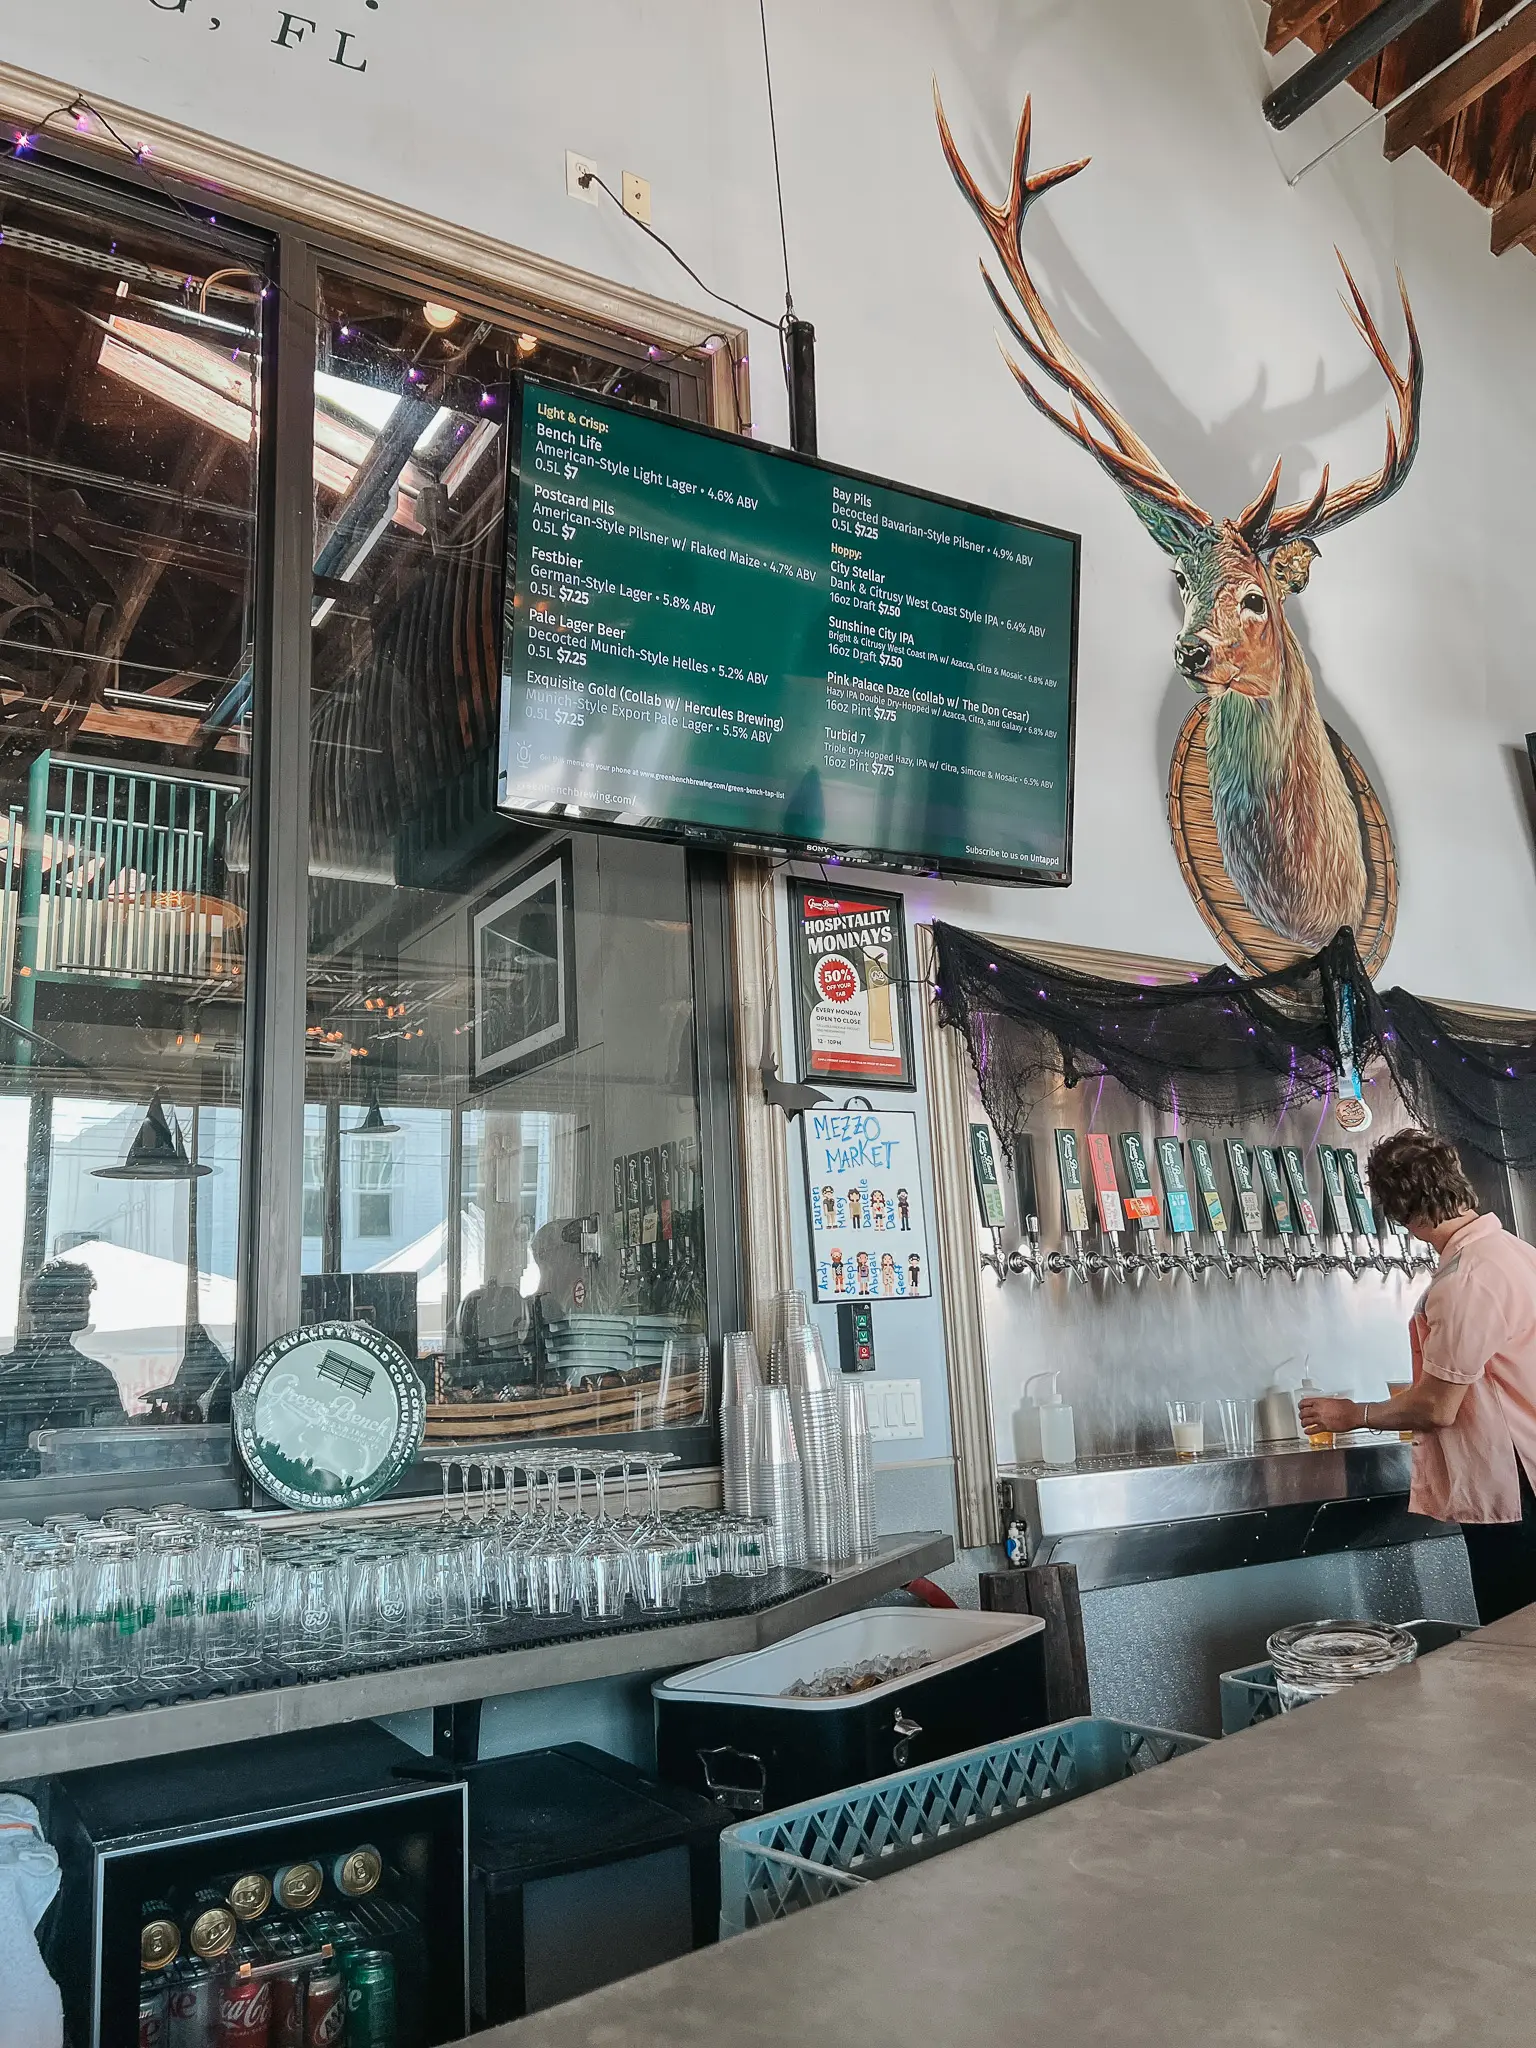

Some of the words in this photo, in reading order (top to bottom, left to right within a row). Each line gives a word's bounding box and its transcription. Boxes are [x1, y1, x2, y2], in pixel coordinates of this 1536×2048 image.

[271, 10, 367, 72] FL
[537, 402, 566, 421] Light
[567, 411, 577, 424] &
[579, 415, 609, 434] Crisp:
[537, 422, 576, 445] Bench
[579, 434, 602, 452] Life
[535, 457, 561, 475] 0.5L
[563, 463, 579, 480] $7
[535, 440, 630, 476] American-Style
[633, 466, 663, 486] Light
[666, 475, 698, 494] Lager
[707, 487, 734, 505] 4.6%
[736, 495, 759, 511] ABV
[534, 483, 589, 510] Postcard
[592, 499, 615, 516] Pils
[833, 486, 852, 504] Bay
[854, 492, 872, 508] Pils
[532, 518, 559, 536] 0.5L
[561, 524, 576, 541] $7
[532, 501, 625, 535] American-Style
[629, 525, 669, 546] Pilsner
[671, 537, 687, 552] w/
[690, 540, 727, 561] Flaked
[729, 550, 761, 569] Maize
[769, 561, 794, 577] 4.7%
[795, 567, 817, 582] ABV
[831, 517, 852, 534] 0.5L
[854, 522, 879, 540] $7.25
[832, 502, 879, 525] Decocted
[881, 515, 951, 545] Bavarian-Style
[953, 535, 985, 554] Pilsner
[992, 547, 1014, 562] 4.9%
[1015, 553, 1034, 567] ABV
[531, 546, 583, 569] Festbier
[831, 542, 862, 561] Hoppy:
[830, 560, 850, 578] City
[852, 565, 886, 584] Stellar
[530, 564, 616, 594] German-Style
[619, 583, 653, 602] Lager
[662, 593, 691, 611] 5.8%
[692, 600, 716, 616] ABV
[530, 581, 556, 598] 0.5L
[558, 585, 589, 605] $7.25
[829, 591, 851, 606] 16oz
[853, 596, 876, 612] Draft
[877, 601, 901, 618] $7.50
[830, 575, 856, 593] Dank
[858, 582, 867, 595] &
[869, 585, 904, 606] Citrusy
[905, 594, 929, 610] West
[931, 601, 958, 617] Coast
[959, 607, 983, 623] Style
[984, 613, 999, 627] IPA
[1006, 619, 1027, 634] 6.4%
[1028, 625, 1046, 638] ABV
[529, 608, 556, 625] Pale
[559, 614, 595, 634] Lager
[597, 622, 626, 640] Beer
[828, 615, 876, 637] Sunshine
[878, 627, 897, 643] City
[899, 631, 915, 646] IPA
[527, 643, 554, 660] 0.5L
[556, 647, 587, 666] $7.25
[528, 625, 587, 649] Decocted
[591, 638, 669, 666] Munich-Style
[672, 655, 709, 674] Helles
[718, 664, 744, 681] 5.2%
[746, 671, 769, 686] ABV
[828, 642, 850, 658] 16oz
[852, 647, 877, 663] Draft
[879, 652, 903, 668] $7.50
[828, 630, 852, 644] Bright
[852, 635, 859, 645] &
[860, 637, 887, 653] Citrusy
[887, 643, 905, 655] West
[906, 647, 926, 660] Coast
[927, 652, 939, 662] IPA
[939, 655, 950, 665] w/
[950, 657, 976, 672] Azacca,
[976, 663, 992, 674] Citra
[993, 667, 999, 675] &
[1000, 668, 1023, 681] Mosaic
[1028, 675, 1044, 685] 6.8%
[1044, 679, 1058, 688] ABV
[527, 670, 585, 692] Exquisite
[588, 682, 617, 699] Gold
[619, 686, 662, 707] (Collab
[665, 697, 681, 711] w/
[684, 700, 734, 721] Hercules
[736, 710, 784, 732] Brewing)
[825, 698, 849, 713] 16oz
[851, 703, 871, 717] Pint
[873, 705, 896, 724] $7.75
[827, 671, 850, 687] Pink
[852, 676, 884, 693] Palace
[886, 683, 910, 699] Daze
[912, 687, 945, 706] (collab
[946, 696, 960, 710] w/
[962, 698, 980, 713] The
[981, 703, 1000, 717] Don
[1001, 707, 1030, 724] Cesar)
[611, 703, 650, 724] Export
[654, 710, 678, 726] Pale
[682, 716, 713, 735] Lager
[722, 723, 748, 739] 5.5%
[750, 729, 772, 743] ABV
[824, 726, 858, 743] Turbid
[860, 733, 866, 745] 7
[823, 754, 847, 769] 16oz
[849, 758, 871, 773] Pint
[871, 760, 895, 777] $7.75
[806, 844, 829, 853] SONY
[965, 845, 1000, 858] Subscribe
[1001, 850, 1009, 859] to
[1010, 852, 1019, 860] us
[1019, 853, 1029, 861] on
[1030, 853, 1059, 866] Untappd
[805, 909, 890, 935] HOSPITALITY
[808, 927, 893, 955] MONDAYS
[824, 968, 851, 983] 50%
[836, 981, 852, 990] YOUR
[816, 1006, 835, 1015] EVERY
[836, 1007, 861, 1017] MONDAY
[814, 1115, 880, 1141] MEZZO
[826, 1140, 899, 1173] MARKET
[812, 1186, 823, 1230] Lauren
[839, 1197, 848, 1228] Mikey
[858, 1178, 872, 1228] Danielle
[886, 1199, 895, 1229] Dave
[817, 1261, 831, 1290] Andy
[844, 1257, 856, 1294] Steph
[869, 1252, 881, 1294] Abigail
[894, 1264, 906, 1295] Geoff
[279, 1327, 346, 1351] QUALITY,
[351, 1332, 389, 1362] BUILD
[268, 1374, 329, 1425] Green
[328, 1396, 390, 1439] Bench
[351, 1484, 371, 1499] FL
